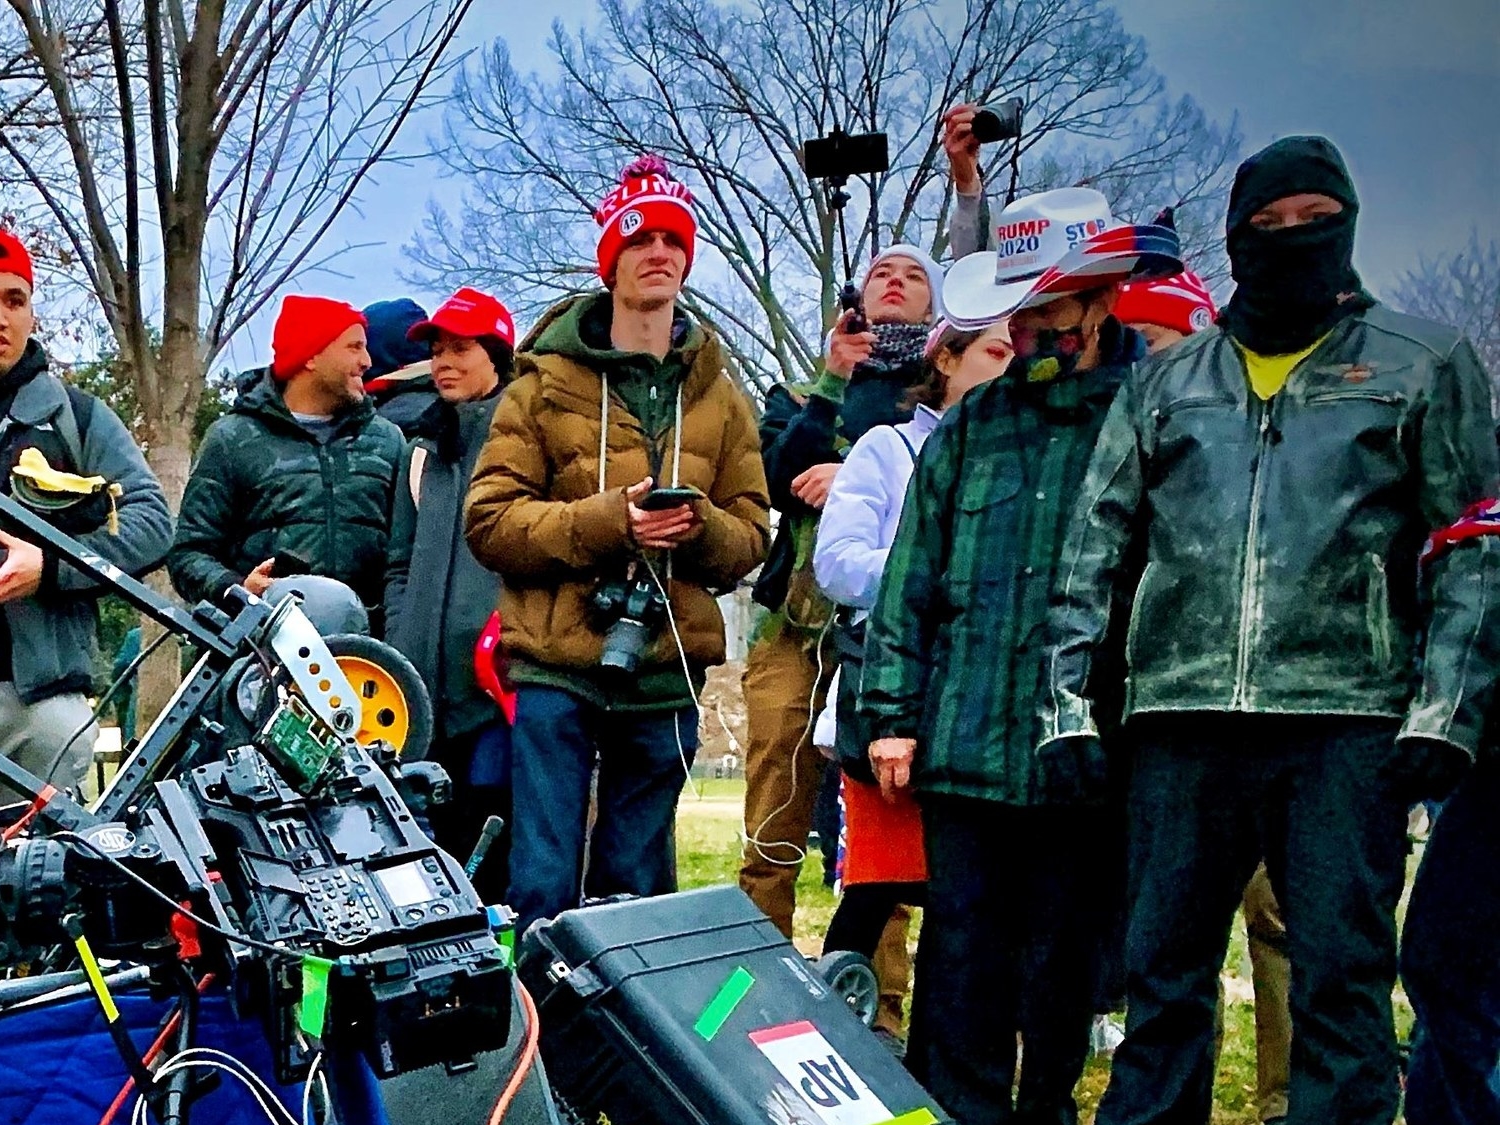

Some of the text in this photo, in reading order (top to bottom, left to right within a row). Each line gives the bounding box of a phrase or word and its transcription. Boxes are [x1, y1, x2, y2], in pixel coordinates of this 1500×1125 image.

[622, 214, 638, 230] 45
[998, 219, 1050, 241] RUMP
[999, 235, 1040, 258] 2020
[798, 1054, 860, 1108] AP
